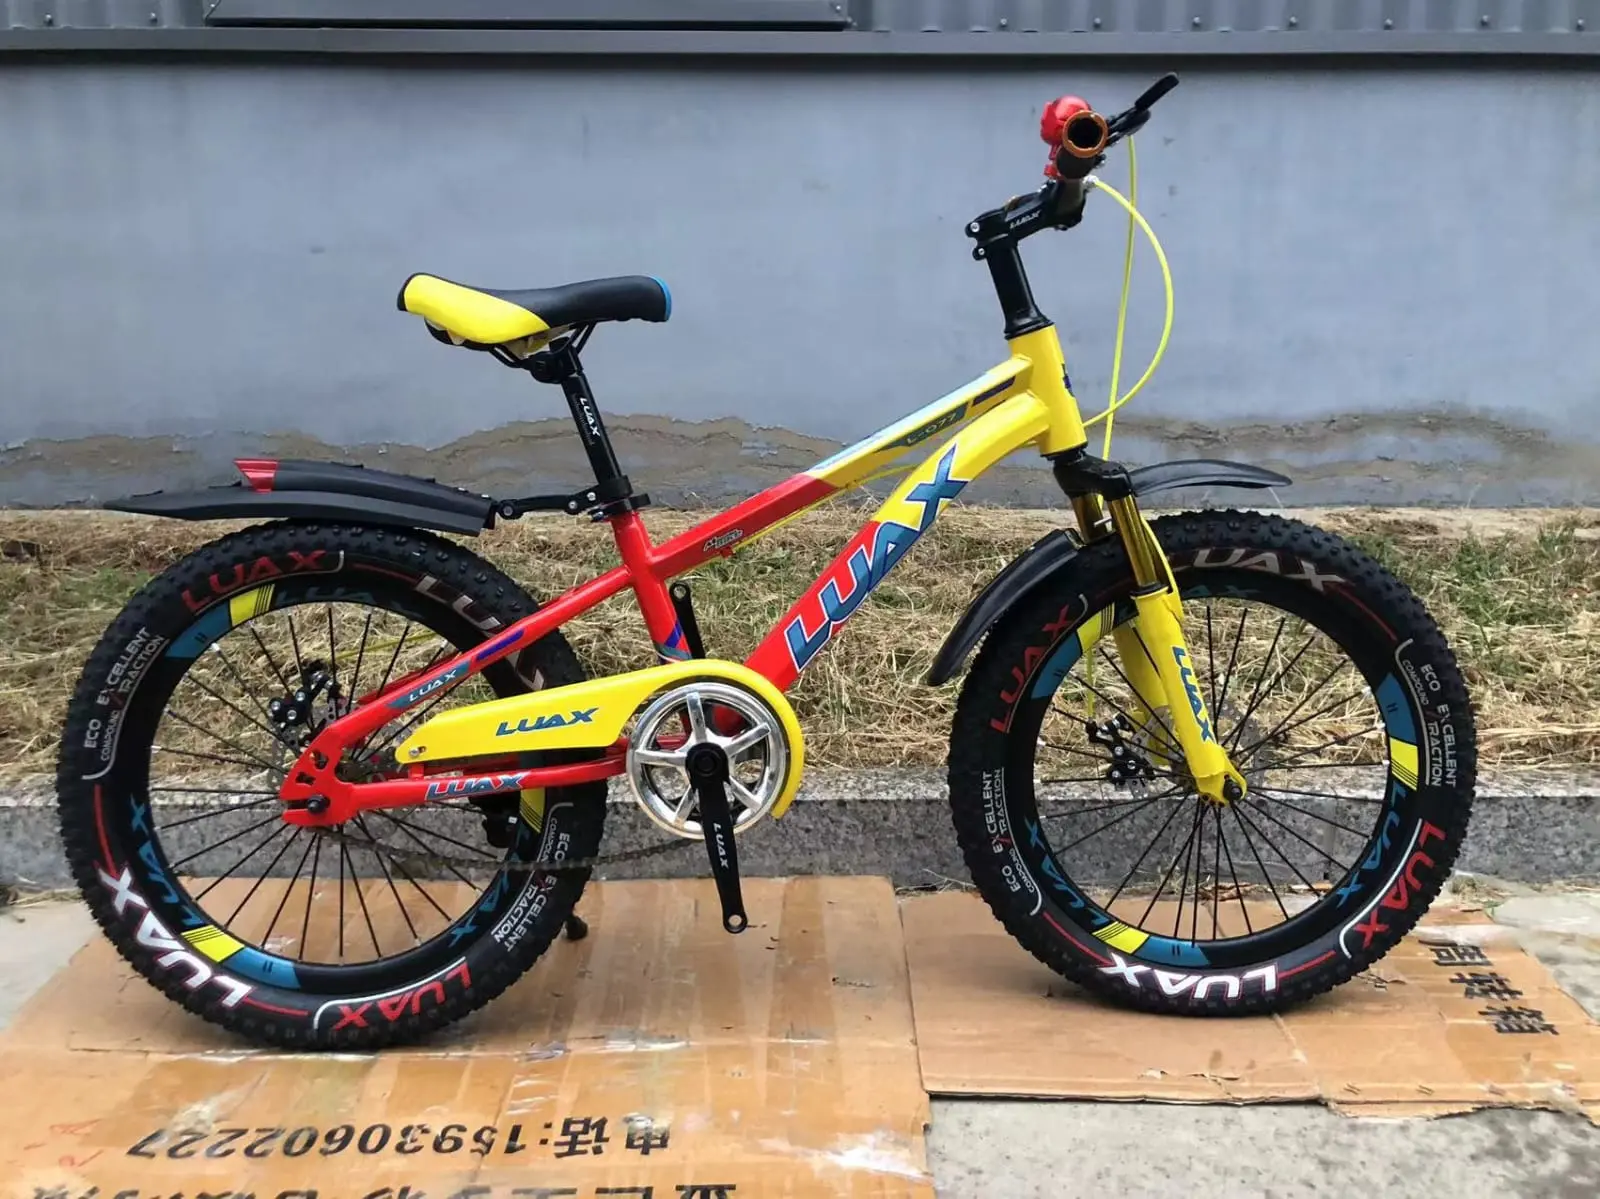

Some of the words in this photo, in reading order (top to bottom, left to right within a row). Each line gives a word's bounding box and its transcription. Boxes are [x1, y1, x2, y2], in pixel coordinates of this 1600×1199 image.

[1009, 209, 1042, 230] LUAX
[580, 397, 600, 437] LUAX
[181, 549, 328, 612] LUAX
[784, 441, 973, 673] LUAX
[83, 718, 102, 749] ECO
[96, 626, 151, 707] EXCELLENT
[118, 633, 165, 694] TRACTION
[408, 669, 457, 701] LUAX
[989, 603, 1075, 734] LUAX
[1171, 644, 1217, 744] LUAX
[495, 707, 600, 737] LUAX
[1418, 662, 1442, 693] ECO
[1437, 703, 1458, 789] EXCELLENT
[1426, 721, 1443, 788] TRACTION
[424, 771, 532, 801] LUAX
[994, 768, 1009, 835] TRACTION
[129, 793, 206, 926] LUAX
[554, 832, 570, 862] ECO
[713, 822, 729, 869] LUAX
[982, 771, 1004, 854] EXCELLENT
[1001, 864, 1021, 893] ECO
[1335, 780, 1407, 910] LUAX
[1024, 815, 1110, 926] LUAX
[1353, 820, 1447, 949] LUAX
[97, 863, 254, 1009] LUAX
[493, 884, 540, 943] TRACTION
[505, 874, 558, 952] EXCELLENT
[332, 961, 472, 1032] LUAX
[1100, 952, 1279, 999] LUAX
